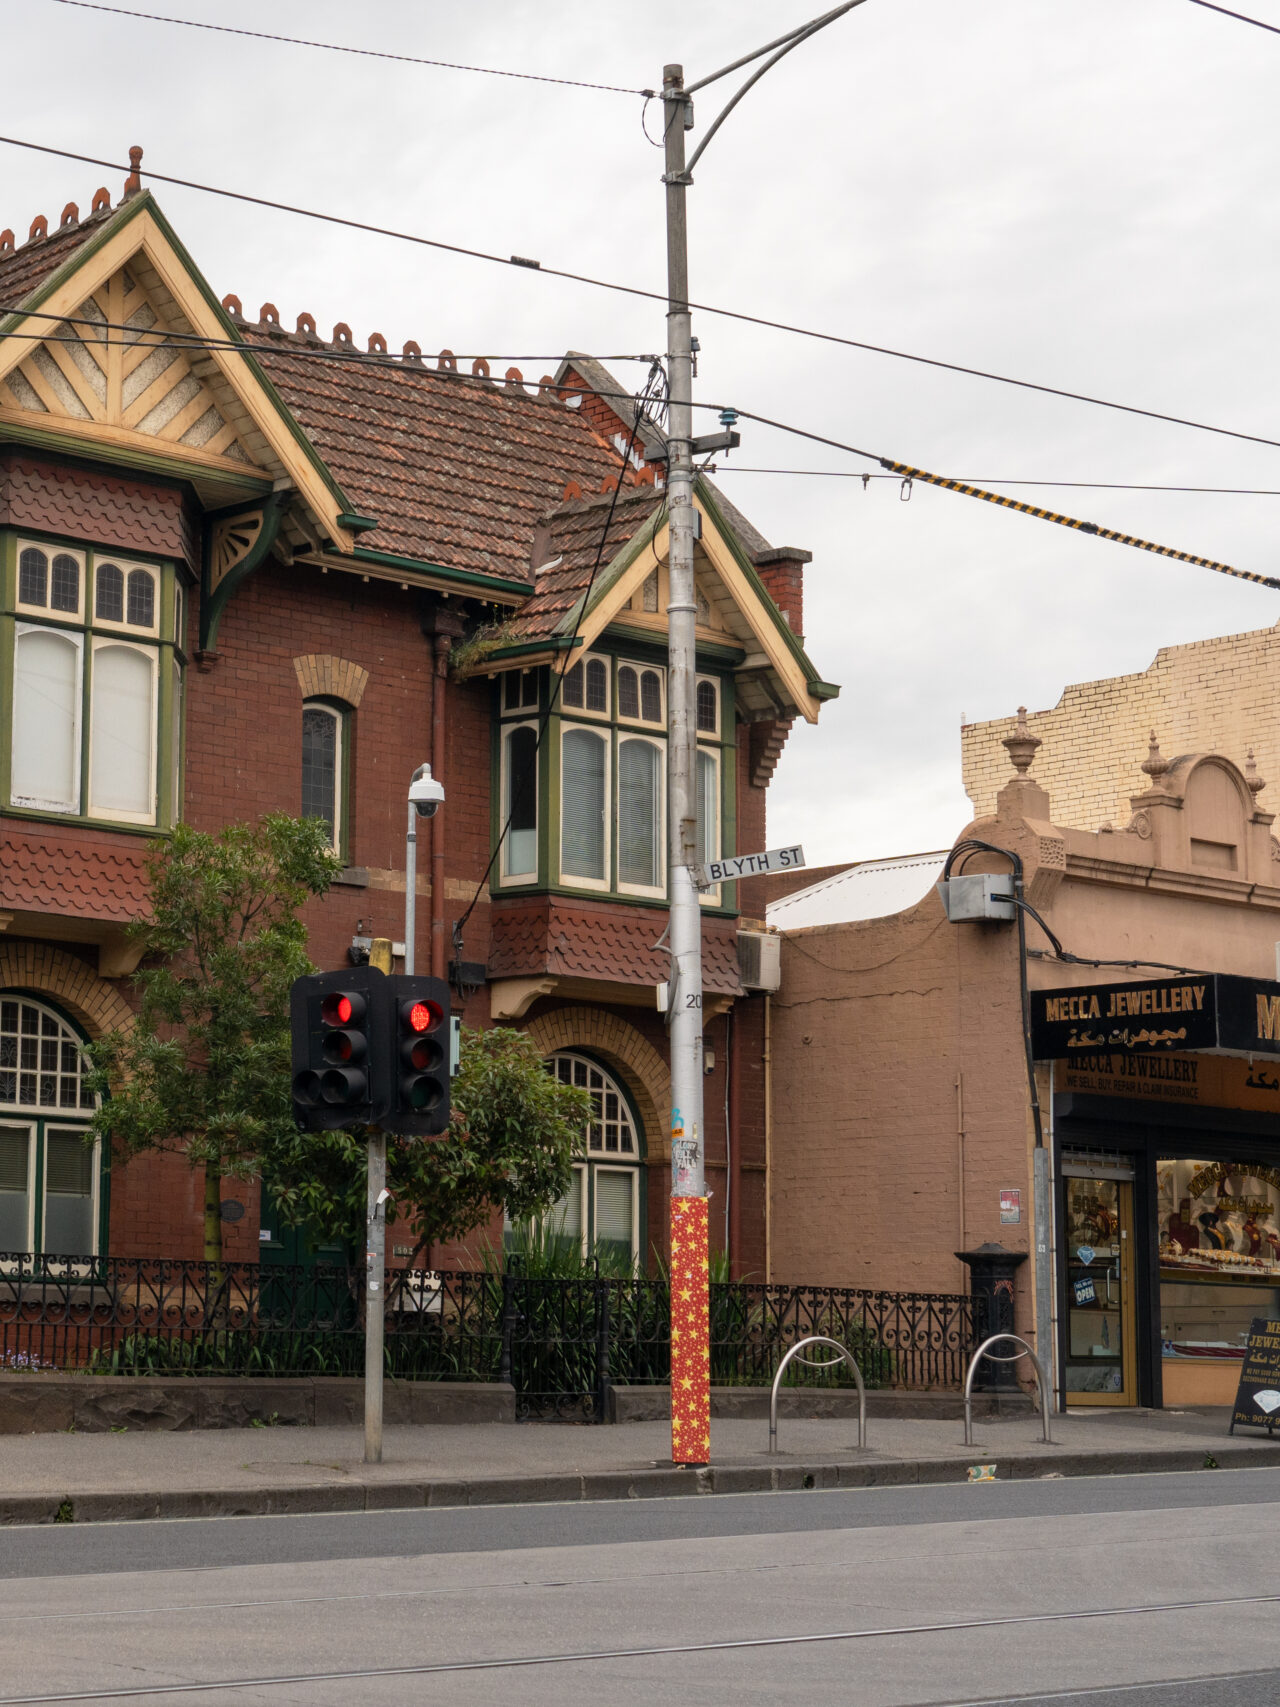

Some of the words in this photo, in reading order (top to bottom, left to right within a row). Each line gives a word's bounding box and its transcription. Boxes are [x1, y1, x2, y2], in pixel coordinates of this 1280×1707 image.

[710, 855, 770, 880] BLYTH
[779, 848, 800, 866] ST
[1045, 994, 1101, 1022] MECCA
[1106, 985, 1206, 1018] JEWELLERY
[1067, 1028, 1105, 1048] مكة
[1108, 1026, 1187, 1048] مجوهرات
[1119, 1054, 1198, 1083] JEWELLERY
[1076, 1286, 1095, 1302] OPEN
[1235, 1412, 1250, 1422] Ph:
[1252, 1414, 1273, 1424] 9077
